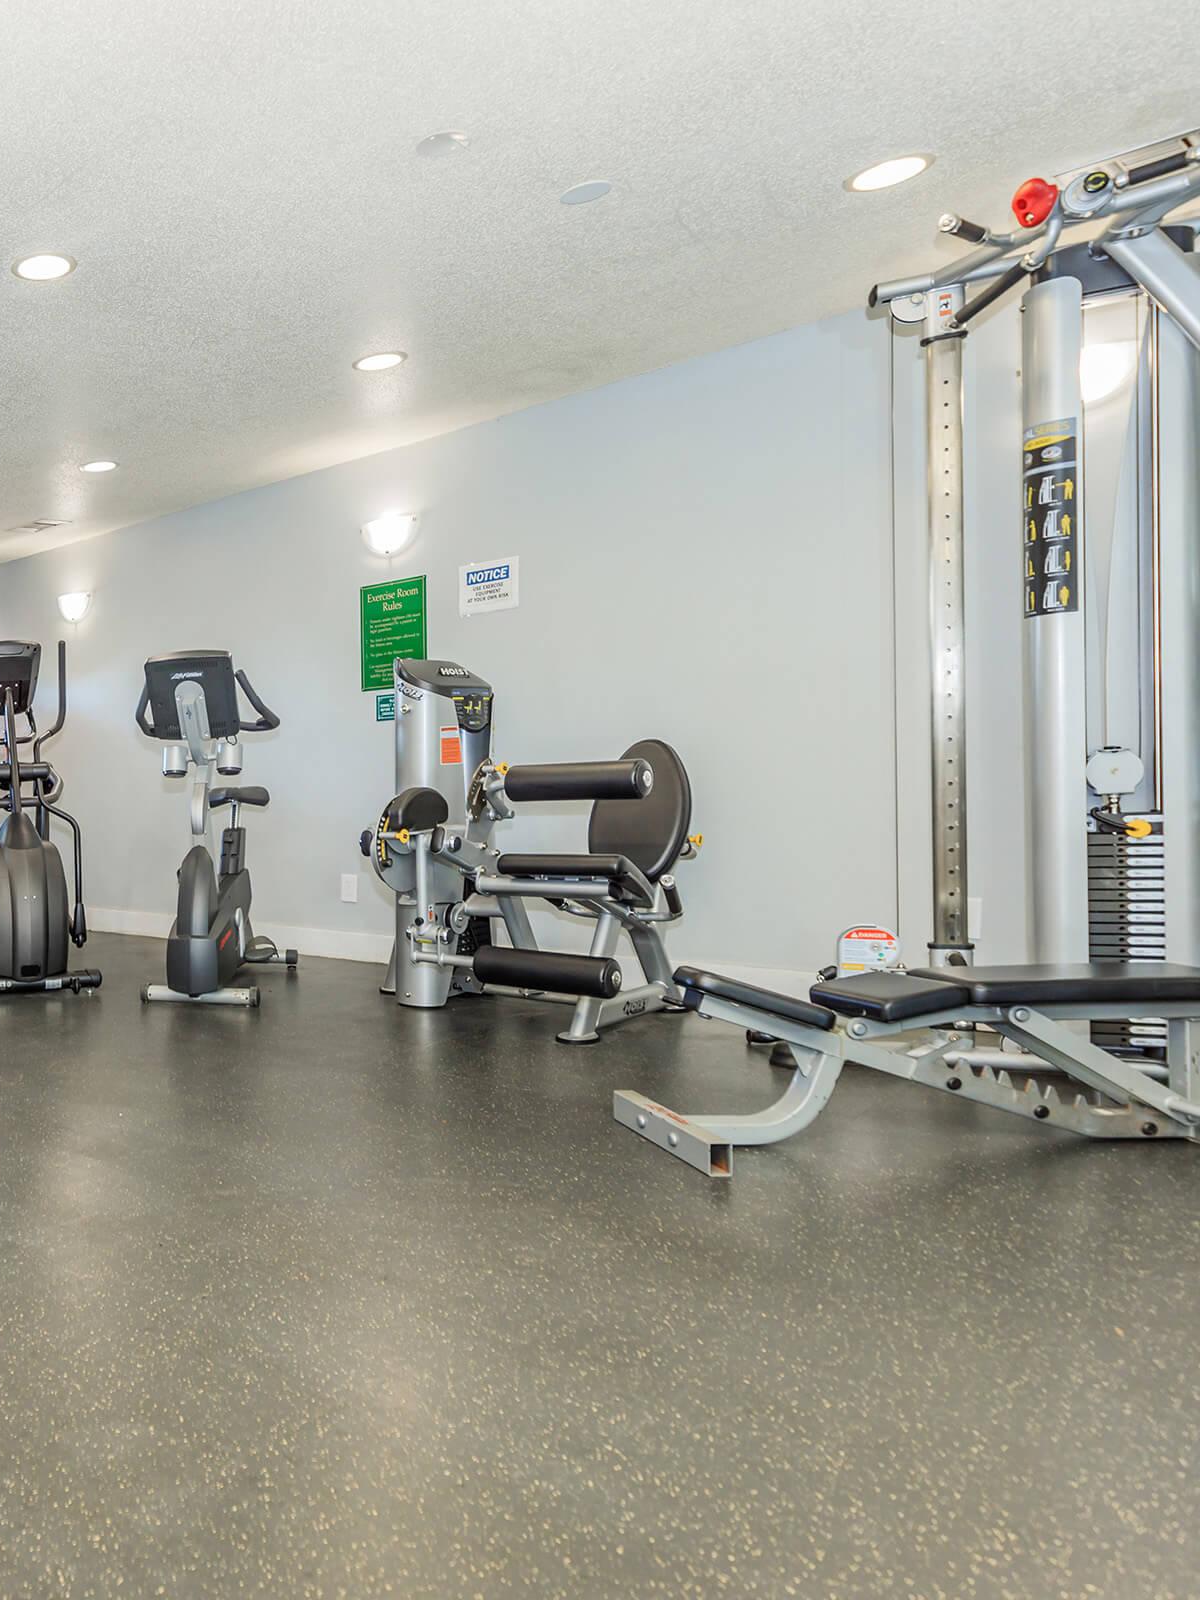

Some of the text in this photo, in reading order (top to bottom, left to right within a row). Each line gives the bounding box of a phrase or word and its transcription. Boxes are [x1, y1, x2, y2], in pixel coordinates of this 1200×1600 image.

[468, 566, 508, 585] NOTICE
[482, 581, 504, 590] EXERCISE
[367, 587, 418, 603] Exercise Room
[475, 588, 502, 597] EQUIPMENT
[382, 600, 402, 611] Rules
[439, 666, 469, 678] HOIST
